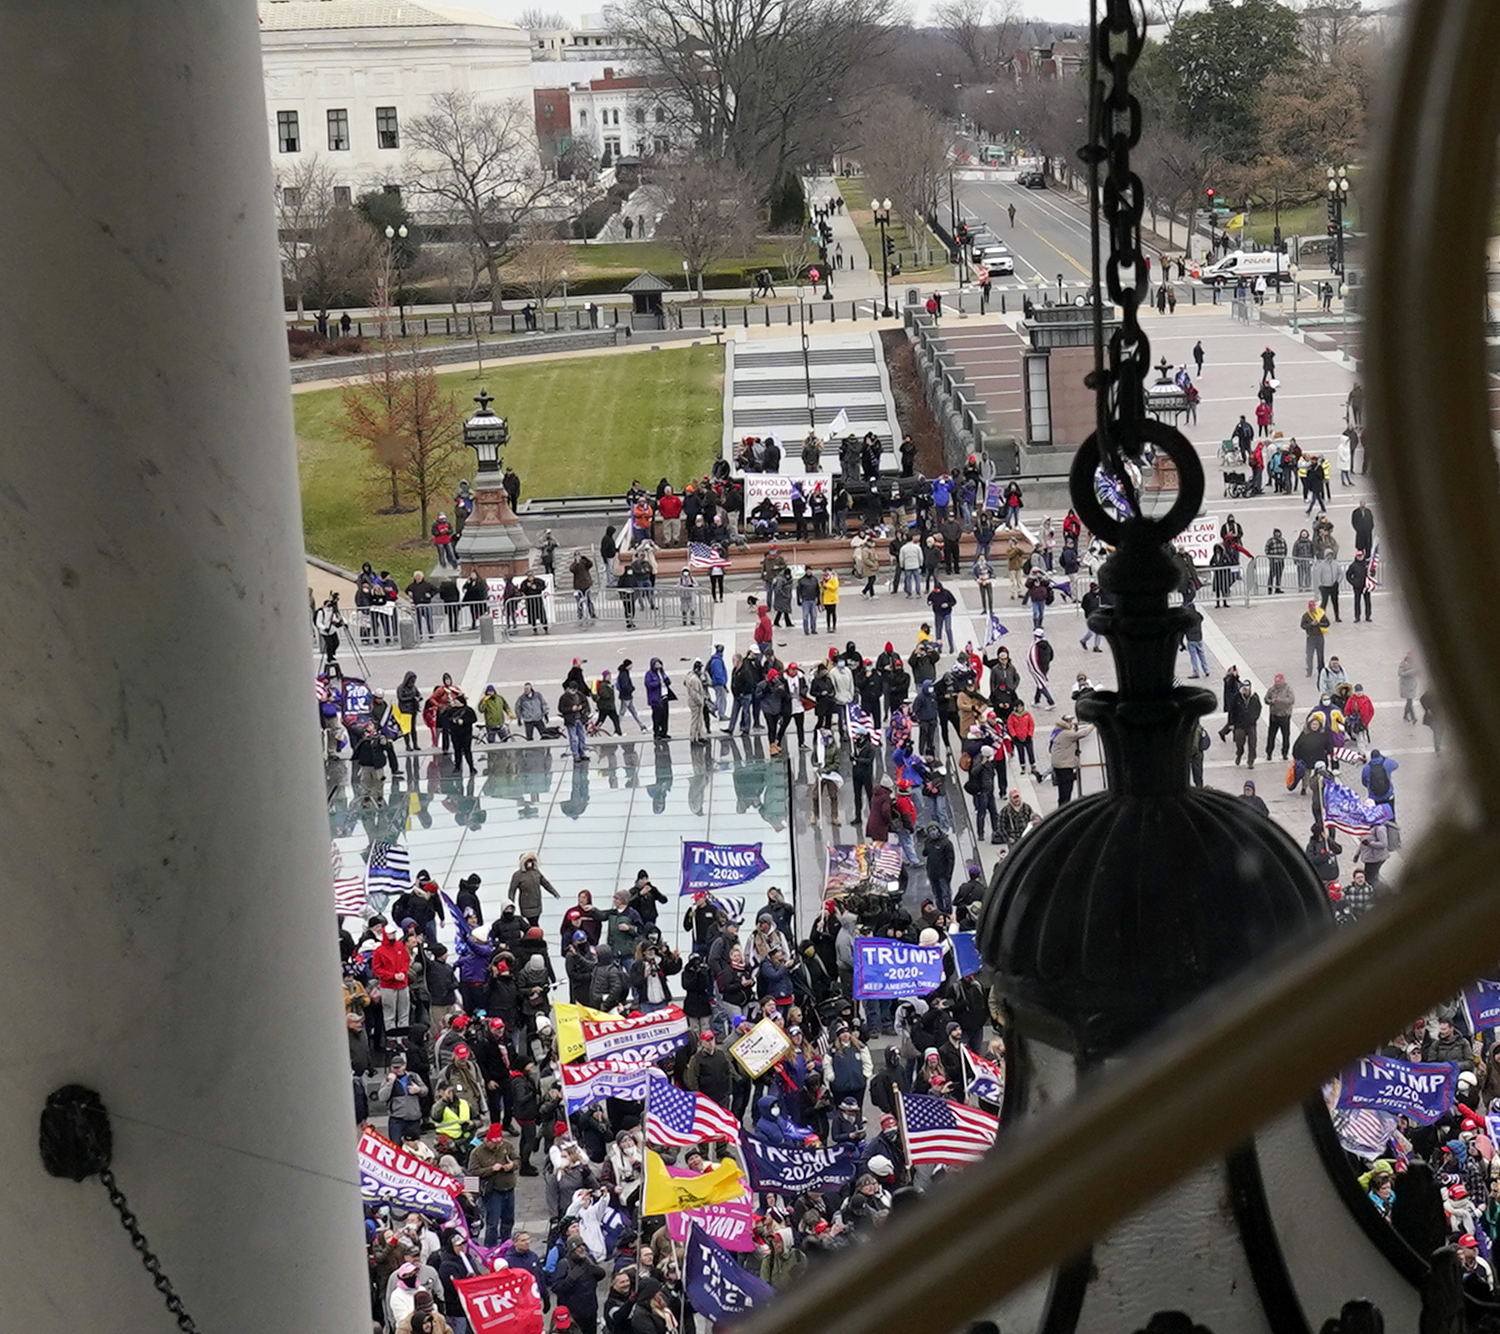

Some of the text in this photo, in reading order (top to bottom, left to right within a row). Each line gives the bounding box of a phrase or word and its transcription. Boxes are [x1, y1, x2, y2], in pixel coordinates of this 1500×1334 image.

[749, 479, 787, 487] UPHOLD
[749, 488, 762, 496] OR
[1193, 523, 1215, 532] LAW
[1174, 534, 1216, 544] MIT CCP
[691, 847, 755, 867] TRUMP
[863, 947, 941, 965] TRUMP
[864, 981, 884, 990] KEEP
[884, 980, 917, 990] AMERICA
[1479, 1007, 1500, 1019] KEEP
[613, 1034, 633, 1046] MORE
[361, 1175, 435, 1204] 2020
[783, 1176, 823, 1192] AMERICA
[705, 1207, 726, 1215] FOR
